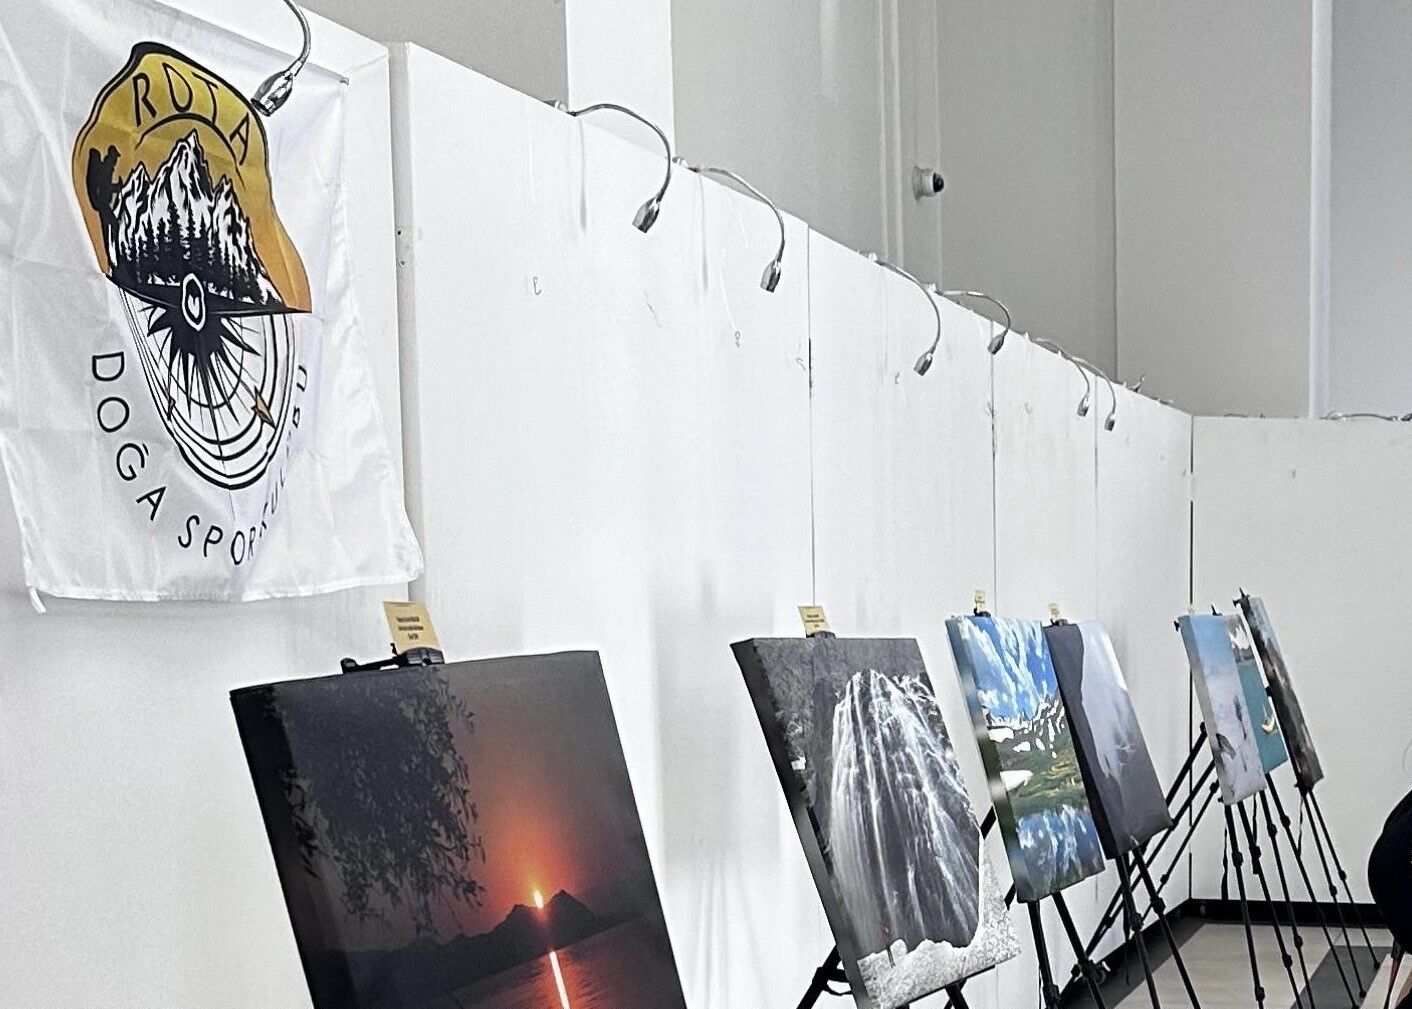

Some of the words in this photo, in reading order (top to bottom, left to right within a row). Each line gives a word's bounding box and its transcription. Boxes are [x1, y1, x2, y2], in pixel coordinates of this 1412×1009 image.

[132, 62, 250, 166] ROTA
[91, 350, 167, 521] DOĞA
[177, 514, 257, 566] SPOR
